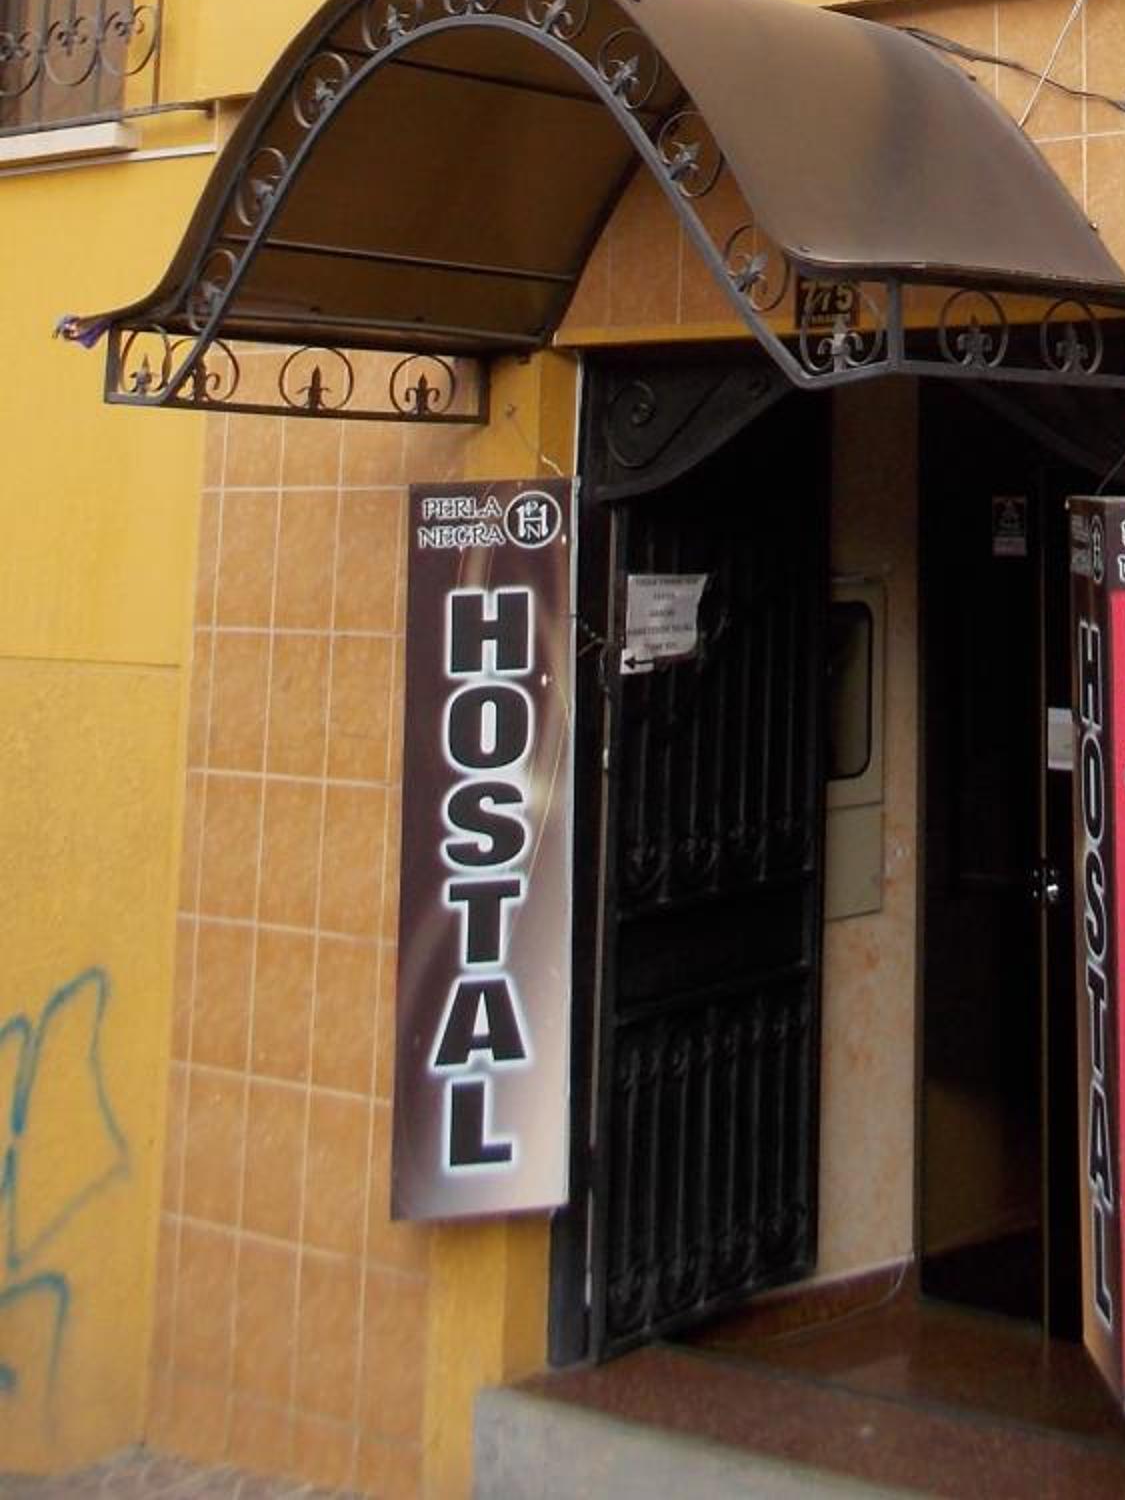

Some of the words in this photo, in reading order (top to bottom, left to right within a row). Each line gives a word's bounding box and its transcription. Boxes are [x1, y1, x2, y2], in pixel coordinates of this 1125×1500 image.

[418, 522, 506, 548] NEGRA
[422, 496, 502, 520] PERLA
[431, 588, 534, 1170] HOSTAL
[1078, 620, 1113, 1329] HOSTAL
